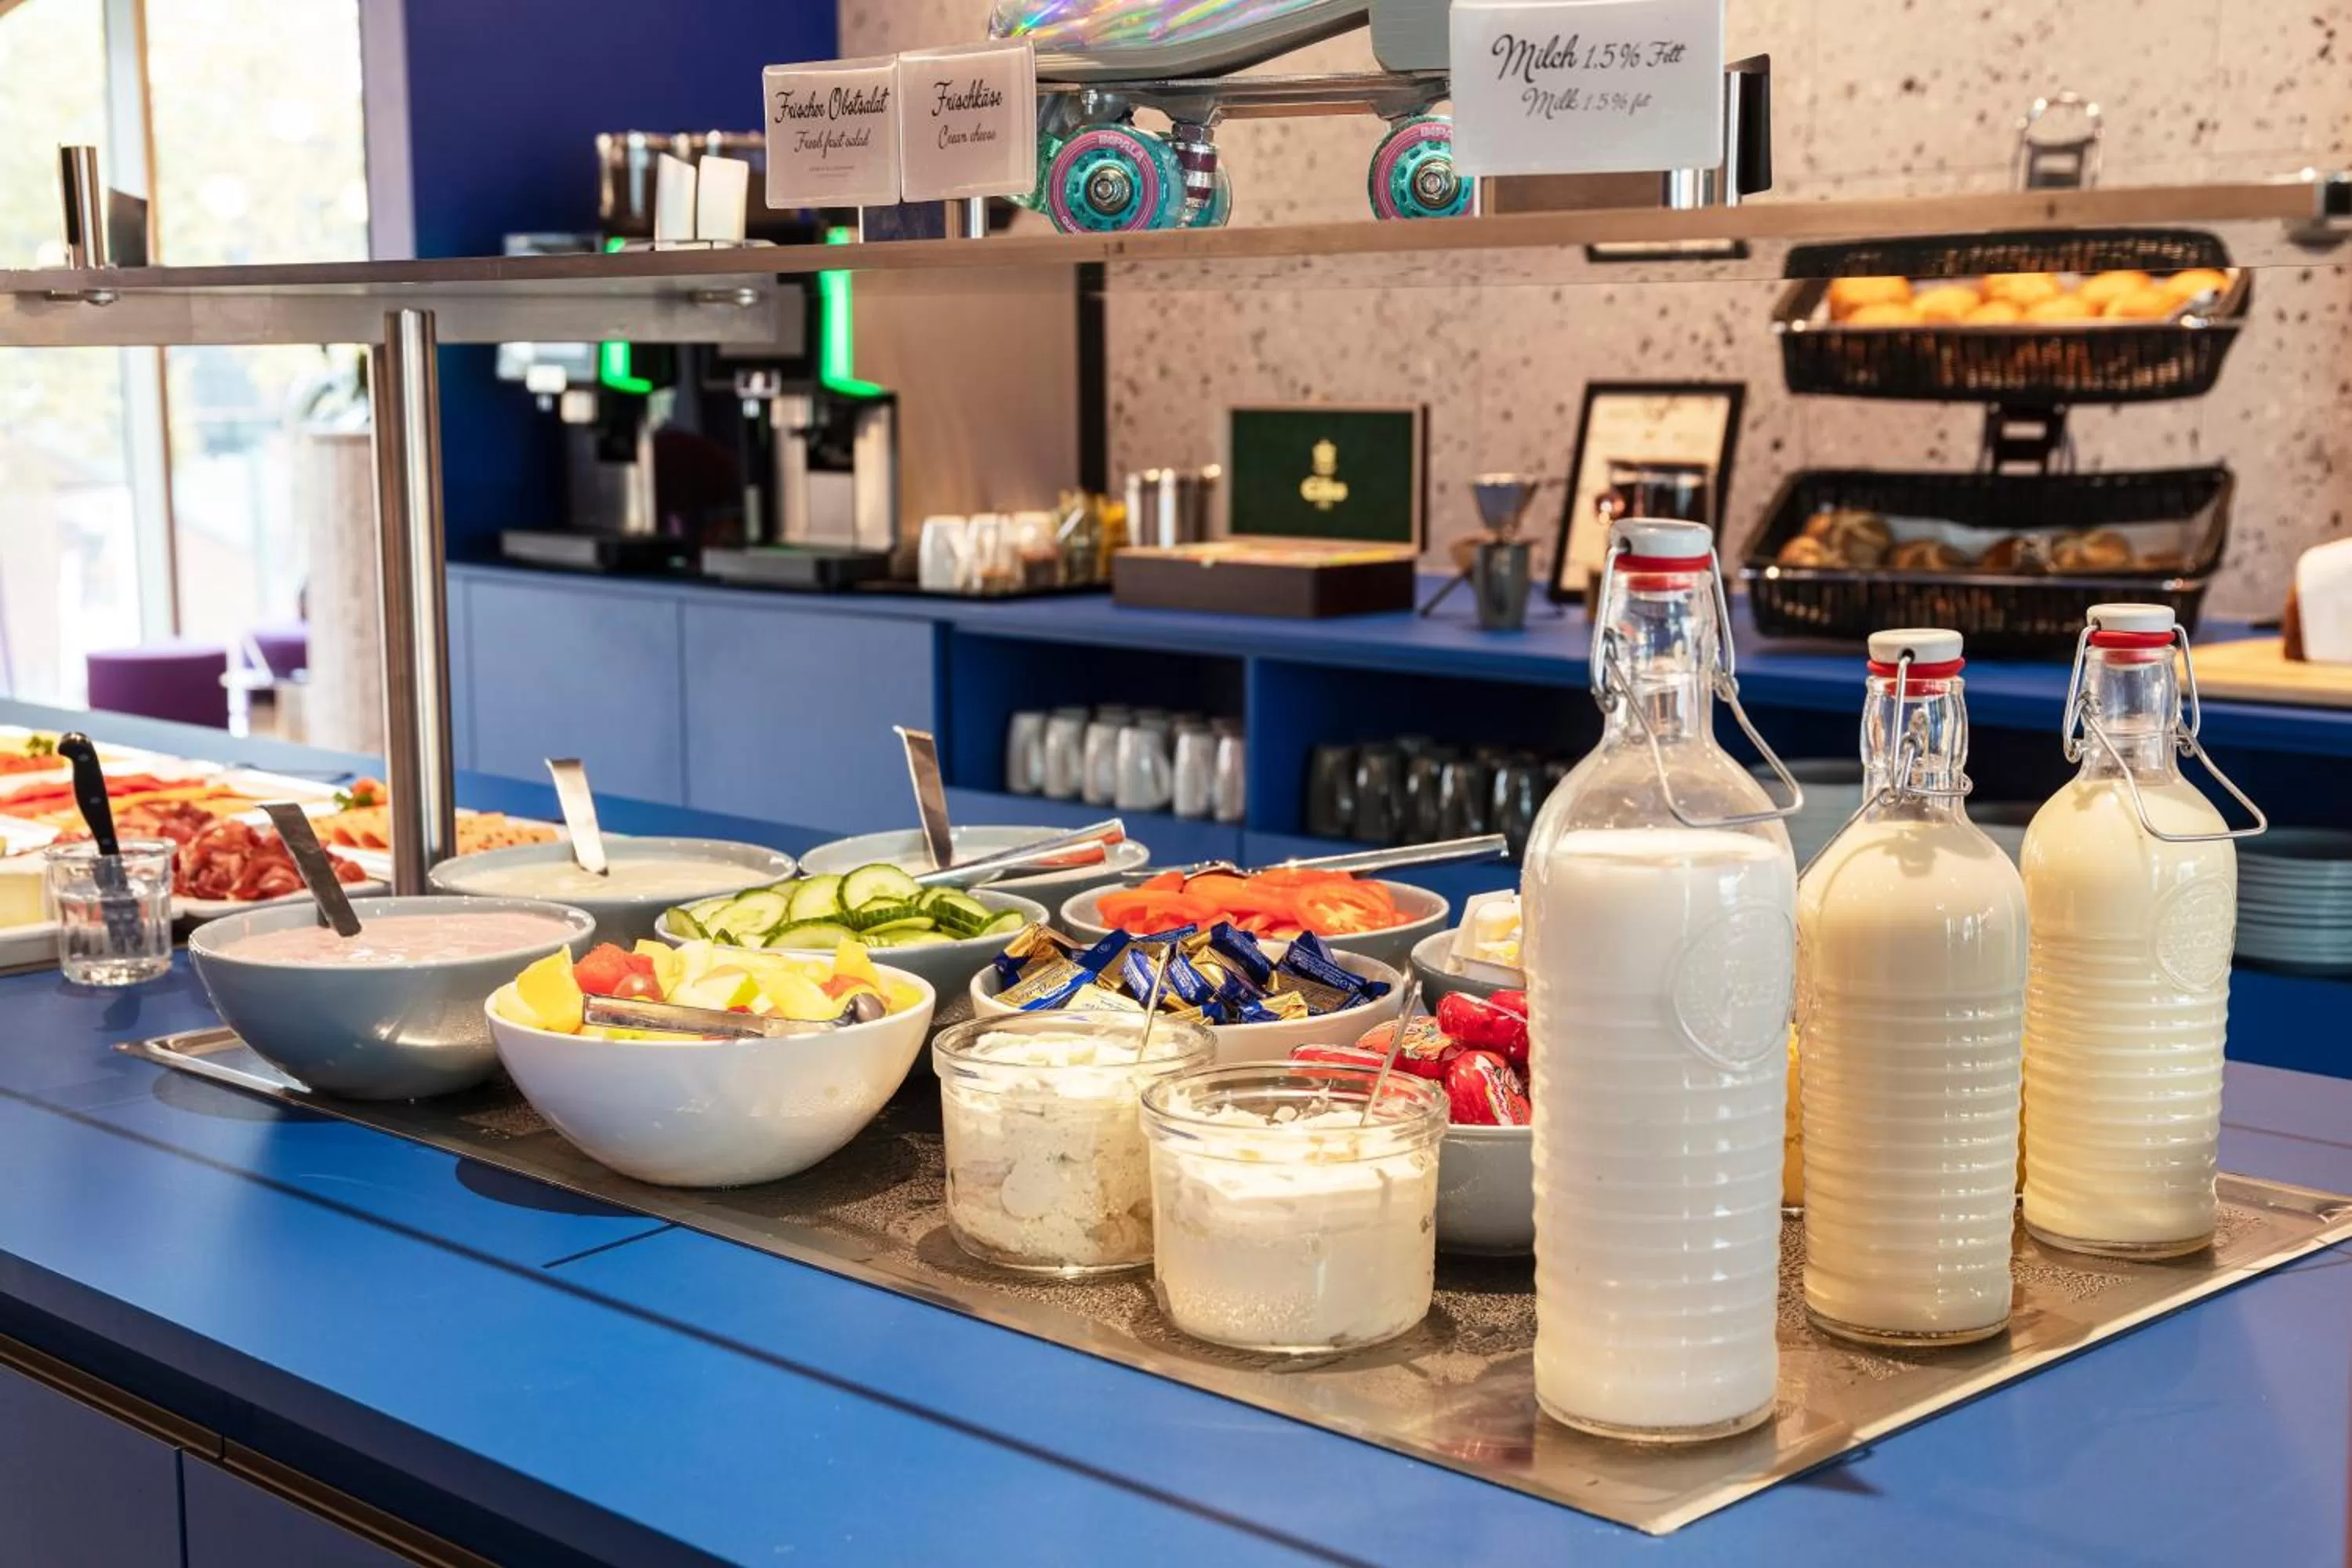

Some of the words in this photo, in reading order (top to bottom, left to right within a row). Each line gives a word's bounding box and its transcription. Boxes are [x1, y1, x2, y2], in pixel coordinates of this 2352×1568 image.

[1492, 34, 1579, 84] Milch
[1646, 40, 1687, 67] Fett
[775, 89, 825, 123] Frischer
[829, 85, 890, 120] Obstsalat
[931, 79, 1003, 117] Frischkäse
[1521, 87, 1580, 120] Milk
[794, 128, 823, 153] Fresh
[938, 125, 967, 150] Cream
[1420, 126, 1452, 138] IMPA
[1098, 133, 1145, 163] IMPALA
